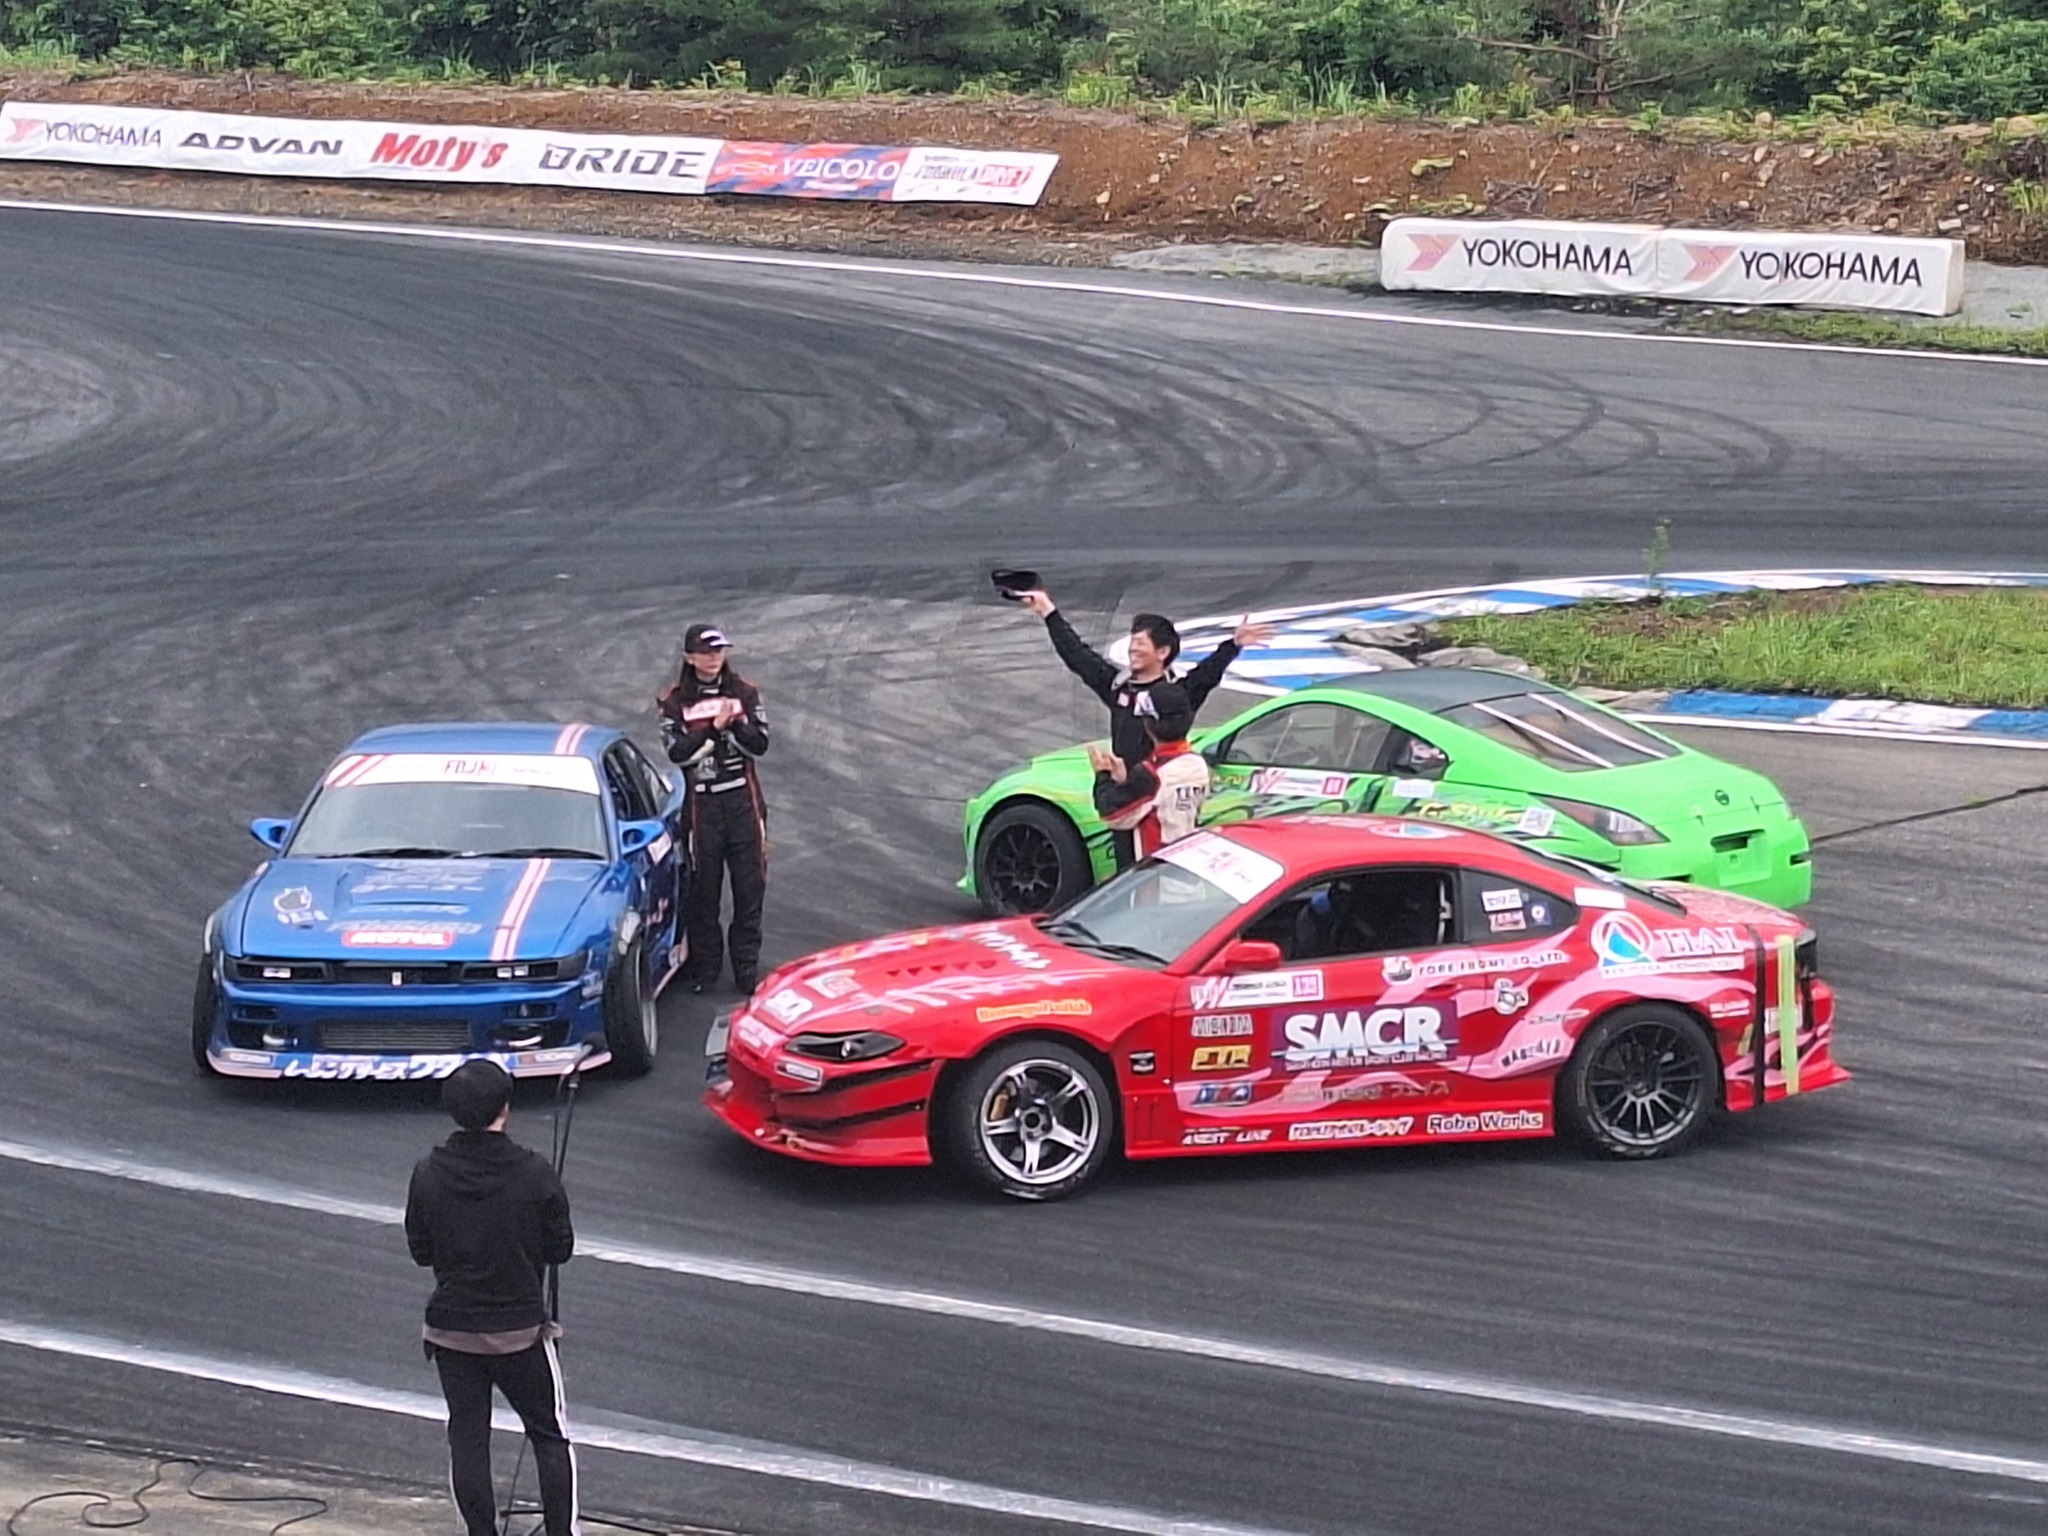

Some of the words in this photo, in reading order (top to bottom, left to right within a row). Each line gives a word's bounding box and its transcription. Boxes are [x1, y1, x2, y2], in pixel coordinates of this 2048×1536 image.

[47, 121, 161, 147] YOKOHAMA
[178, 132, 344, 156] ADVAN
[370, 132, 508, 171] Moty's
[538, 143, 706, 178] BRIDE
[781, 157, 901, 182] VEICOLO
[1462, 239, 1633, 276] YOKOHAMA
[1740, 251, 1923, 288] YOKOHAMA
[1285, 1006, 1448, 1061] SMCR
[1483, 1111, 1541, 1129] Works
